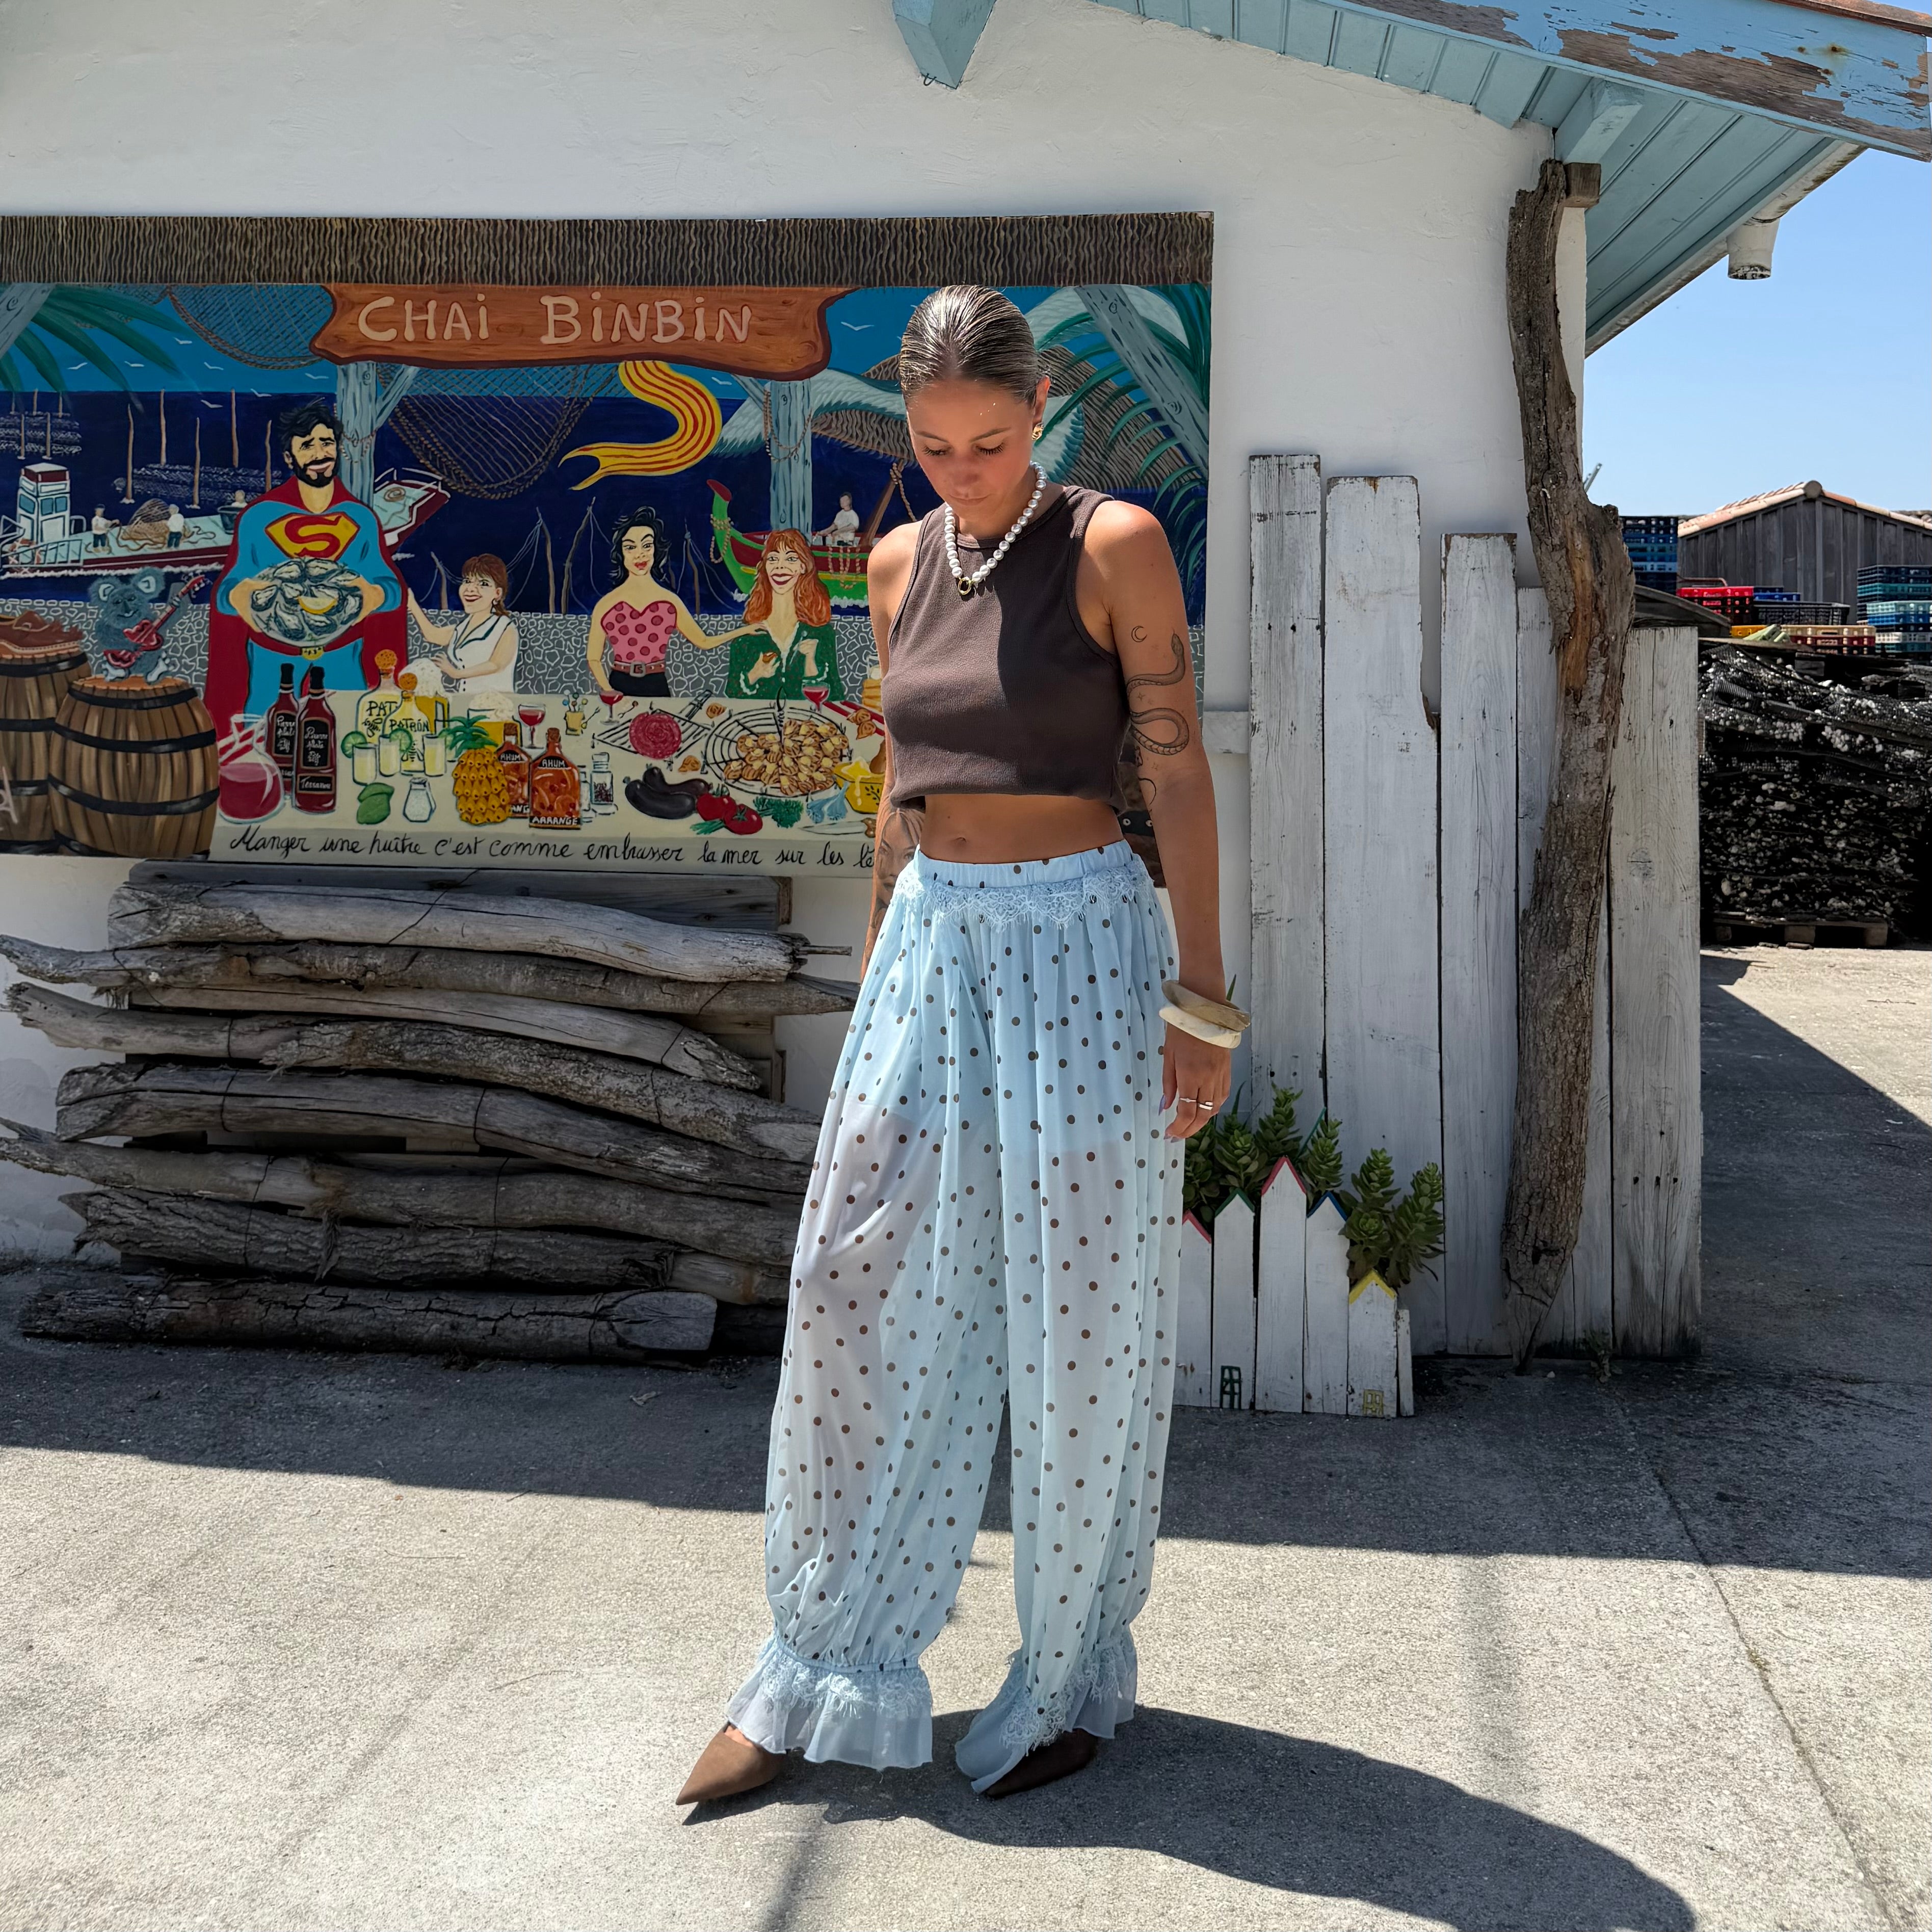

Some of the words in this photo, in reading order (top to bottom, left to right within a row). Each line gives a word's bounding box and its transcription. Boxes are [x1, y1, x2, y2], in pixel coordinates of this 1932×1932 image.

[284, 515, 342, 559] S
[366, 700, 399, 717] PAT
[542, 759, 565, 767] RHUM
[230, 825, 311, 859] Manger
[319, 837, 365, 854] une
[369, 830, 427, 855] huître
[584, 832, 685, 862] embrasser
[697, 840, 717, 863] la
[720, 848, 763, 865] mer
[775, 849, 807, 865] sur
[816, 841, 844, 865] les
